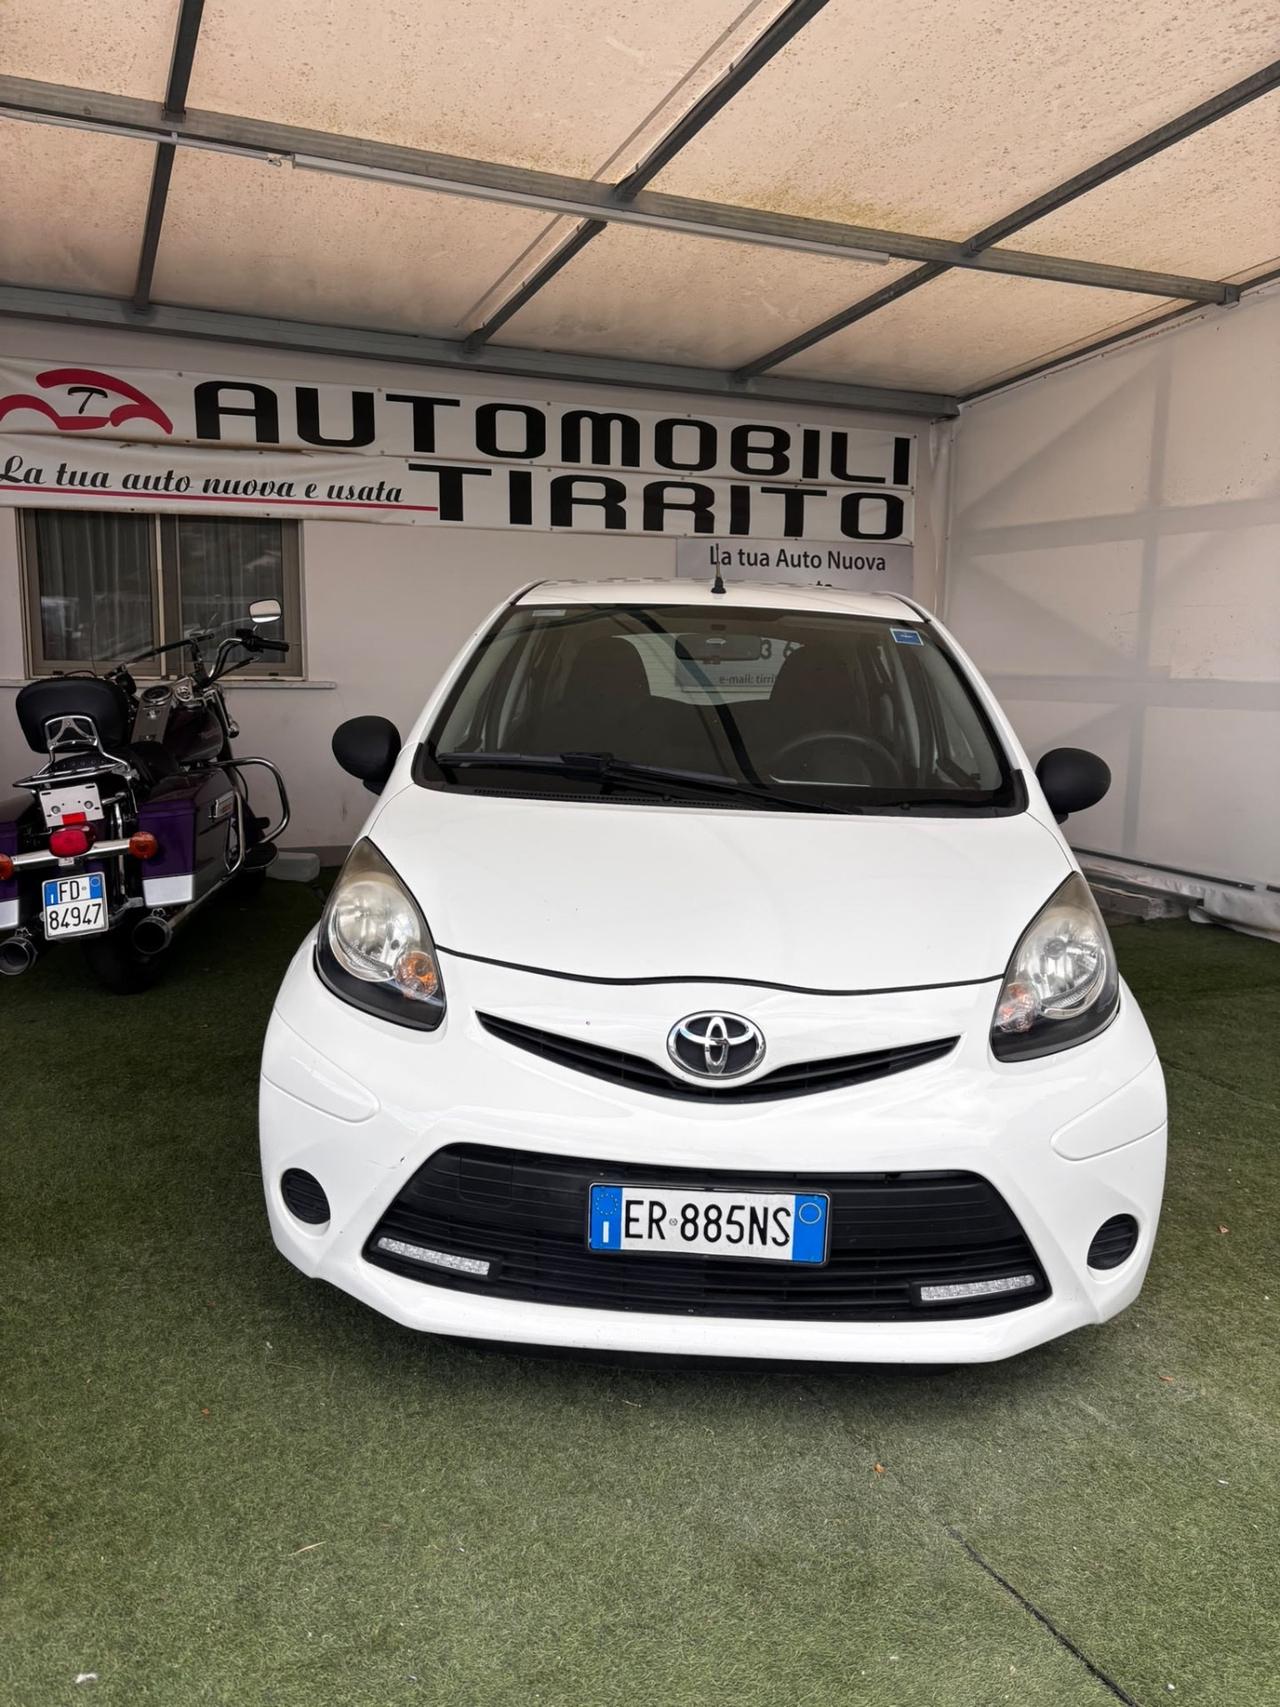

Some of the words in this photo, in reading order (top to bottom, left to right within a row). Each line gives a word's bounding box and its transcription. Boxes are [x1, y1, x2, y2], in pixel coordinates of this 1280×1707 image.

[193, 380, 911, 486] AUTOMOBILI
[0, 455, 46, 485] La
[56, 462, 111, 488] tua
[122, 469, 193, 493] auto
[202, 478, 296, 499] nuova
[304, 482, 319, 499] e
[327, 481, 404, 503] usata
[408, 462, 905, 541] TIRRITO
[709, 545, 731, 566] La
[738, 549, 770, 567] tua
[776, 549, 822, 569] Auto
[828, 550, 886, 571] Nuova
[59, 880, 80, 902] FD
[49, 903, 102, 930] 84947
